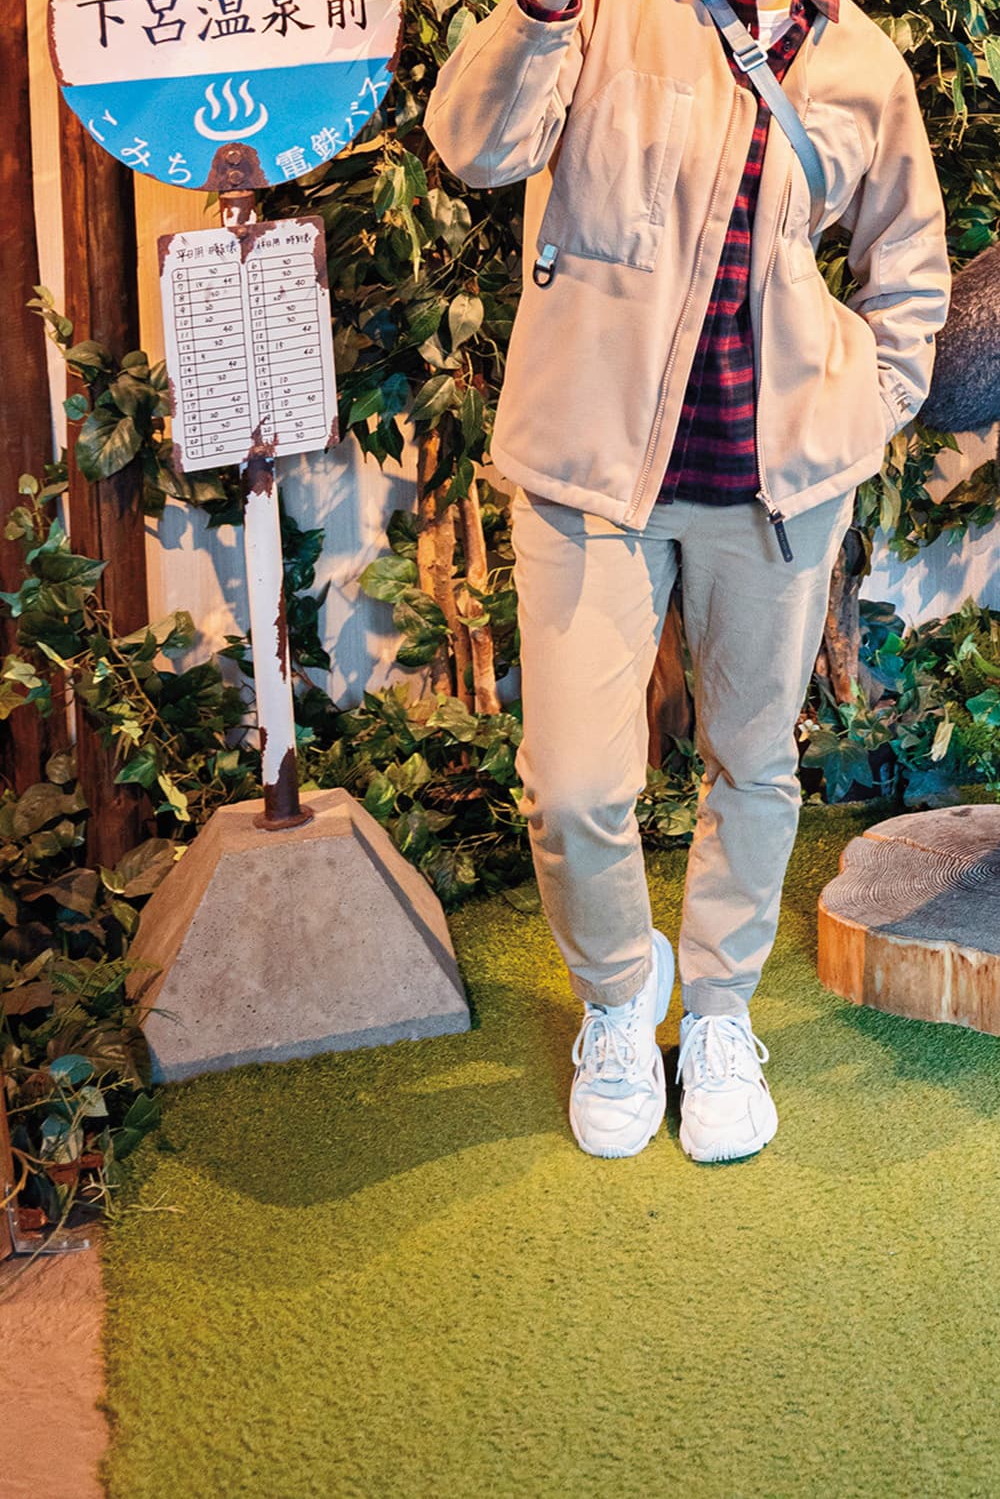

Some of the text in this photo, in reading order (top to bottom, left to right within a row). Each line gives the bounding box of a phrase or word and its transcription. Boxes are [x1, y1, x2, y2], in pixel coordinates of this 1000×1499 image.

[88, 77, 388, 184] こみち 電鉄バス
